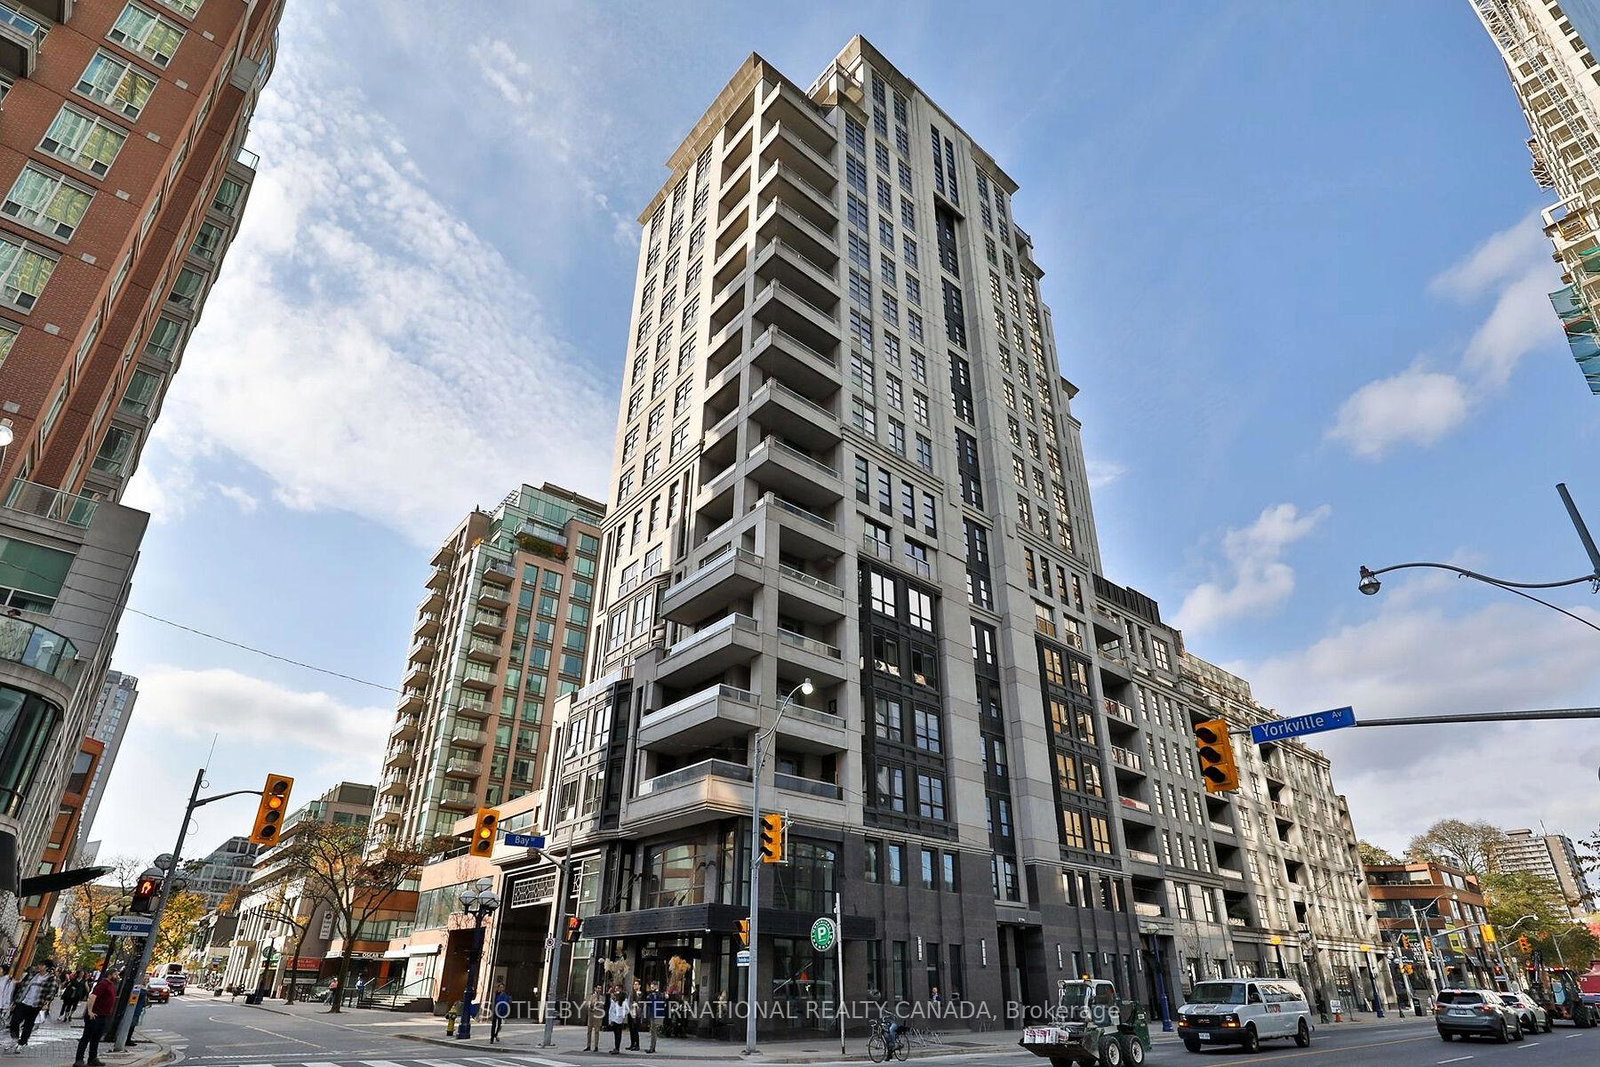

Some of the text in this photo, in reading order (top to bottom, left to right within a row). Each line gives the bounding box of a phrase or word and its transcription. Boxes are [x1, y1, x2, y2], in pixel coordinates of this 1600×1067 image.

[1261, 711, 1342, 737] Yorkville Av
[514, 835, 530, 846] Bay
[121, 923, 133, 932] Bay
[817, 927, 827, 939] P
